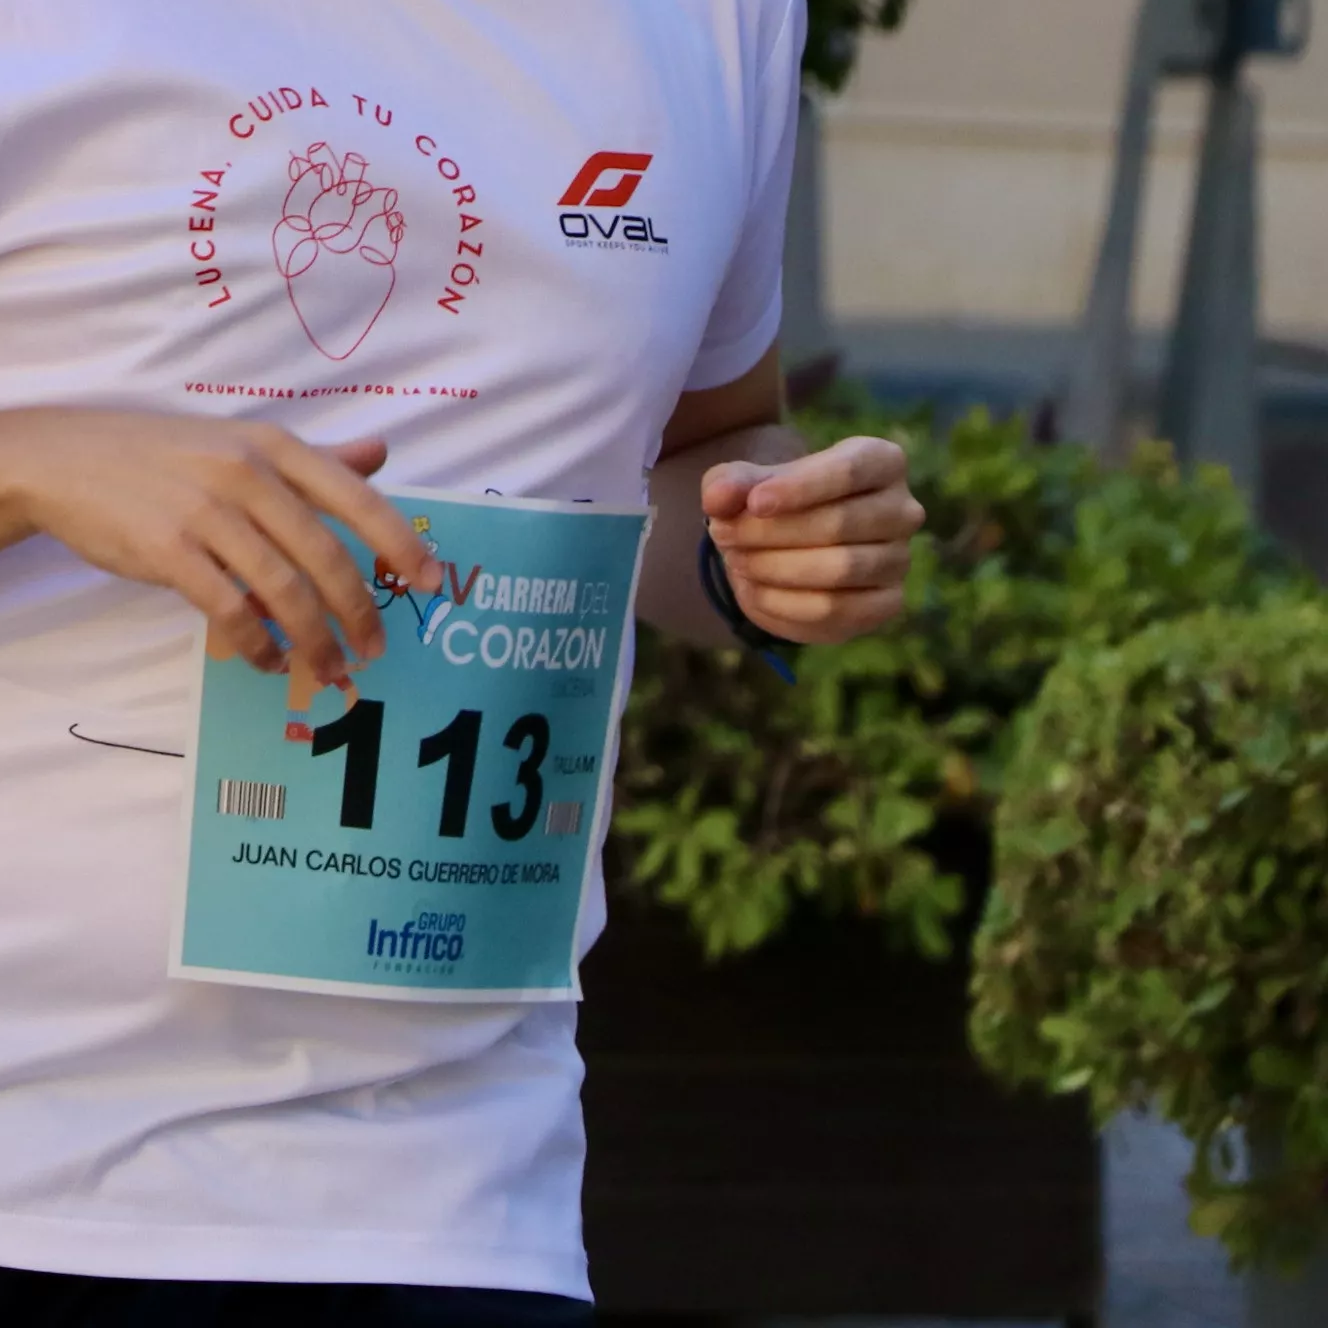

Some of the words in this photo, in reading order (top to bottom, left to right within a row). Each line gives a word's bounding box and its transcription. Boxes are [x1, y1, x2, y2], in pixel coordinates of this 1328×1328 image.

[228, 86, 330, 140] CUIDA
[352, 94, 394, 128] TU
[414, 133, 485, 315] CORAZÓN
[184, 382, 294, 399] VOLUNTARIAS
[300, 384, 358, 398] ACTIVAS
[364, 384, 395, 396] POR
[402, 387, 421, 396] LA
[429, 386, 480, 400] SALUD
[474, 573, 578, 614] CARRERA
[579, 581, 610, 615] DEL
[311, 697, 551, 842] 113
[231, 842, 297, 868] JUAN
[306, 849, 402, 879] CARLOS
[408, 860, 497, 886] GUERRERO
[500, 863, 520, 885] DE
[521, 862, 560, 884] MORA
[418, 911, 466, 933] GRUPO
